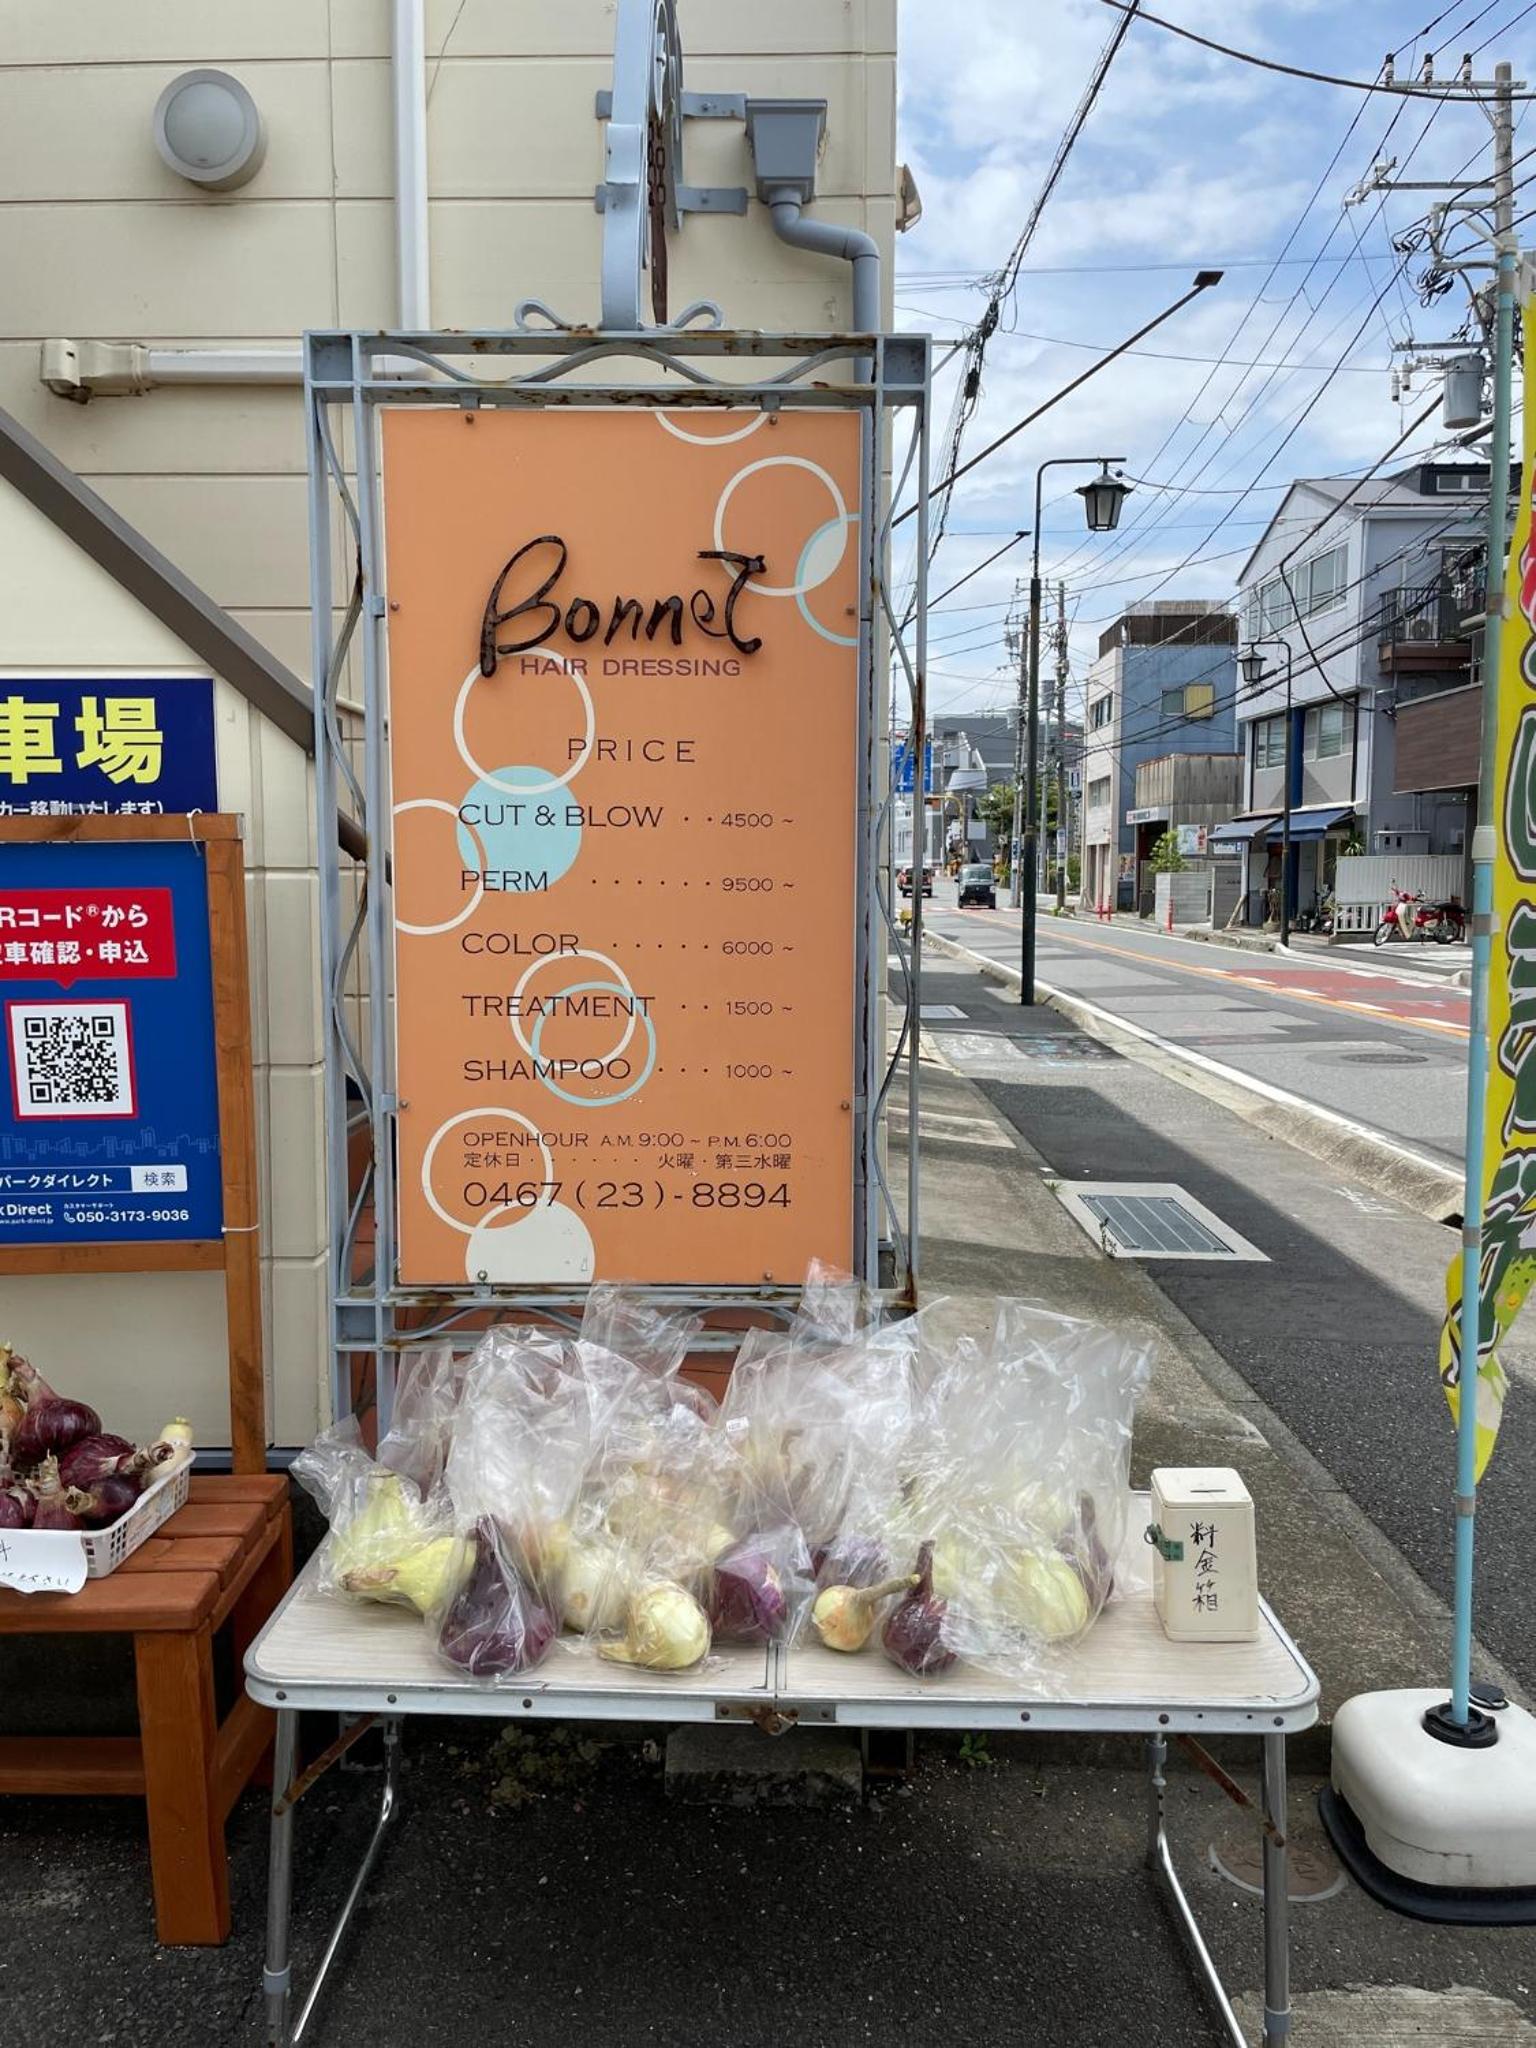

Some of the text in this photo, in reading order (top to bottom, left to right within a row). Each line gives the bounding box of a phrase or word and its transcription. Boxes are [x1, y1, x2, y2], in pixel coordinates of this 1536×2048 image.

[520, 657, 741, 677] HAIR DRESSING
[0, 696, 163, 784] 車場
[567, 738, 696, 762] PRICE
[458, 804, 527, 827] CUT
[534, 805, 556, 827] &
[565, 805, 664, 828] BLOW
[460, 870, 548, 892] PERM
[0, 940, 149, 965] 車確認・申込
[461, 933, 580, 955] COLOR
[462, 995, 656, 1018] TREATMENT
[463, 1058, 631, 1081] SHAMPOO
[463, 1131, 589, 1147] OPENHOUR
[463, 1152, 520, 1168] 定休日
[144, 1171, 176, 1187] 検索
[7, 1203, 53, 1216] Direct
[76, 1209, 190, 1223] 050-3173-9036
[1190, 1521, 1220, 1613] 料金箱
